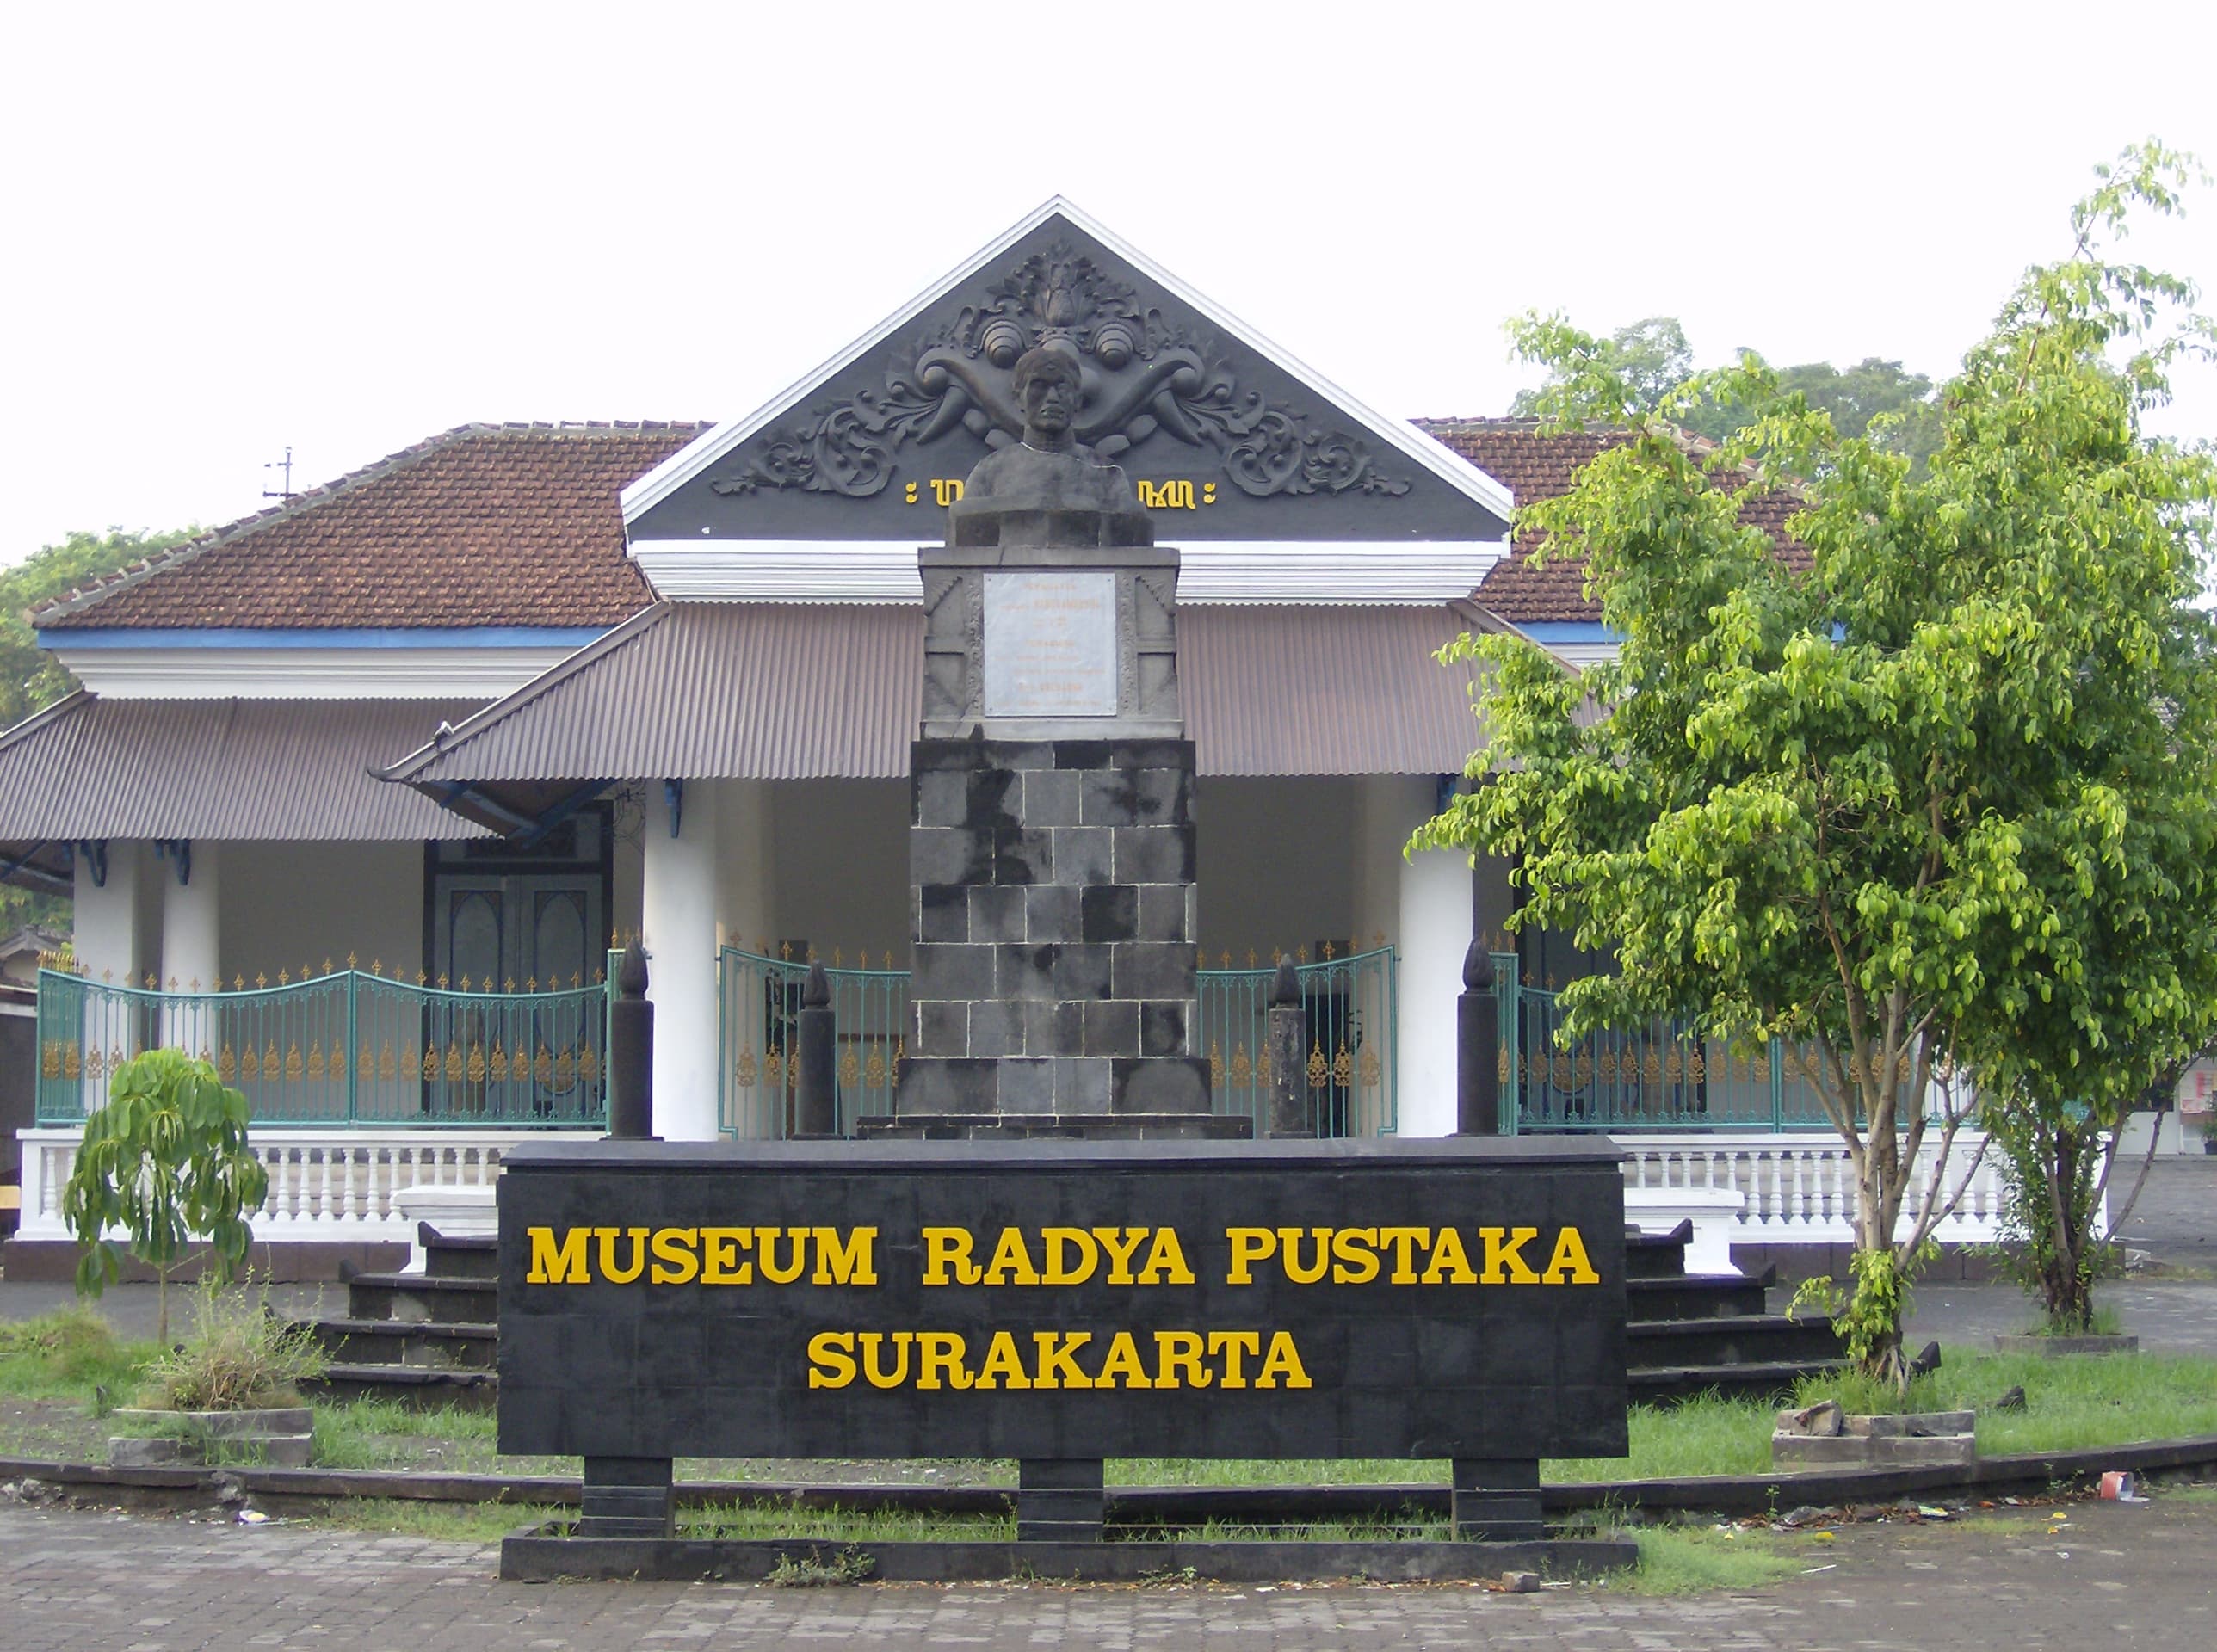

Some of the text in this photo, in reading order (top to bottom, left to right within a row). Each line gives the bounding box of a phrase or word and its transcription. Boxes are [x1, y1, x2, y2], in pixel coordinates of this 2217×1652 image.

[526, 1226, 1600, 1285] MUSEUM RADYA PUSTAKA
[806, 1330, 1312, 1390] SURAKARTA
